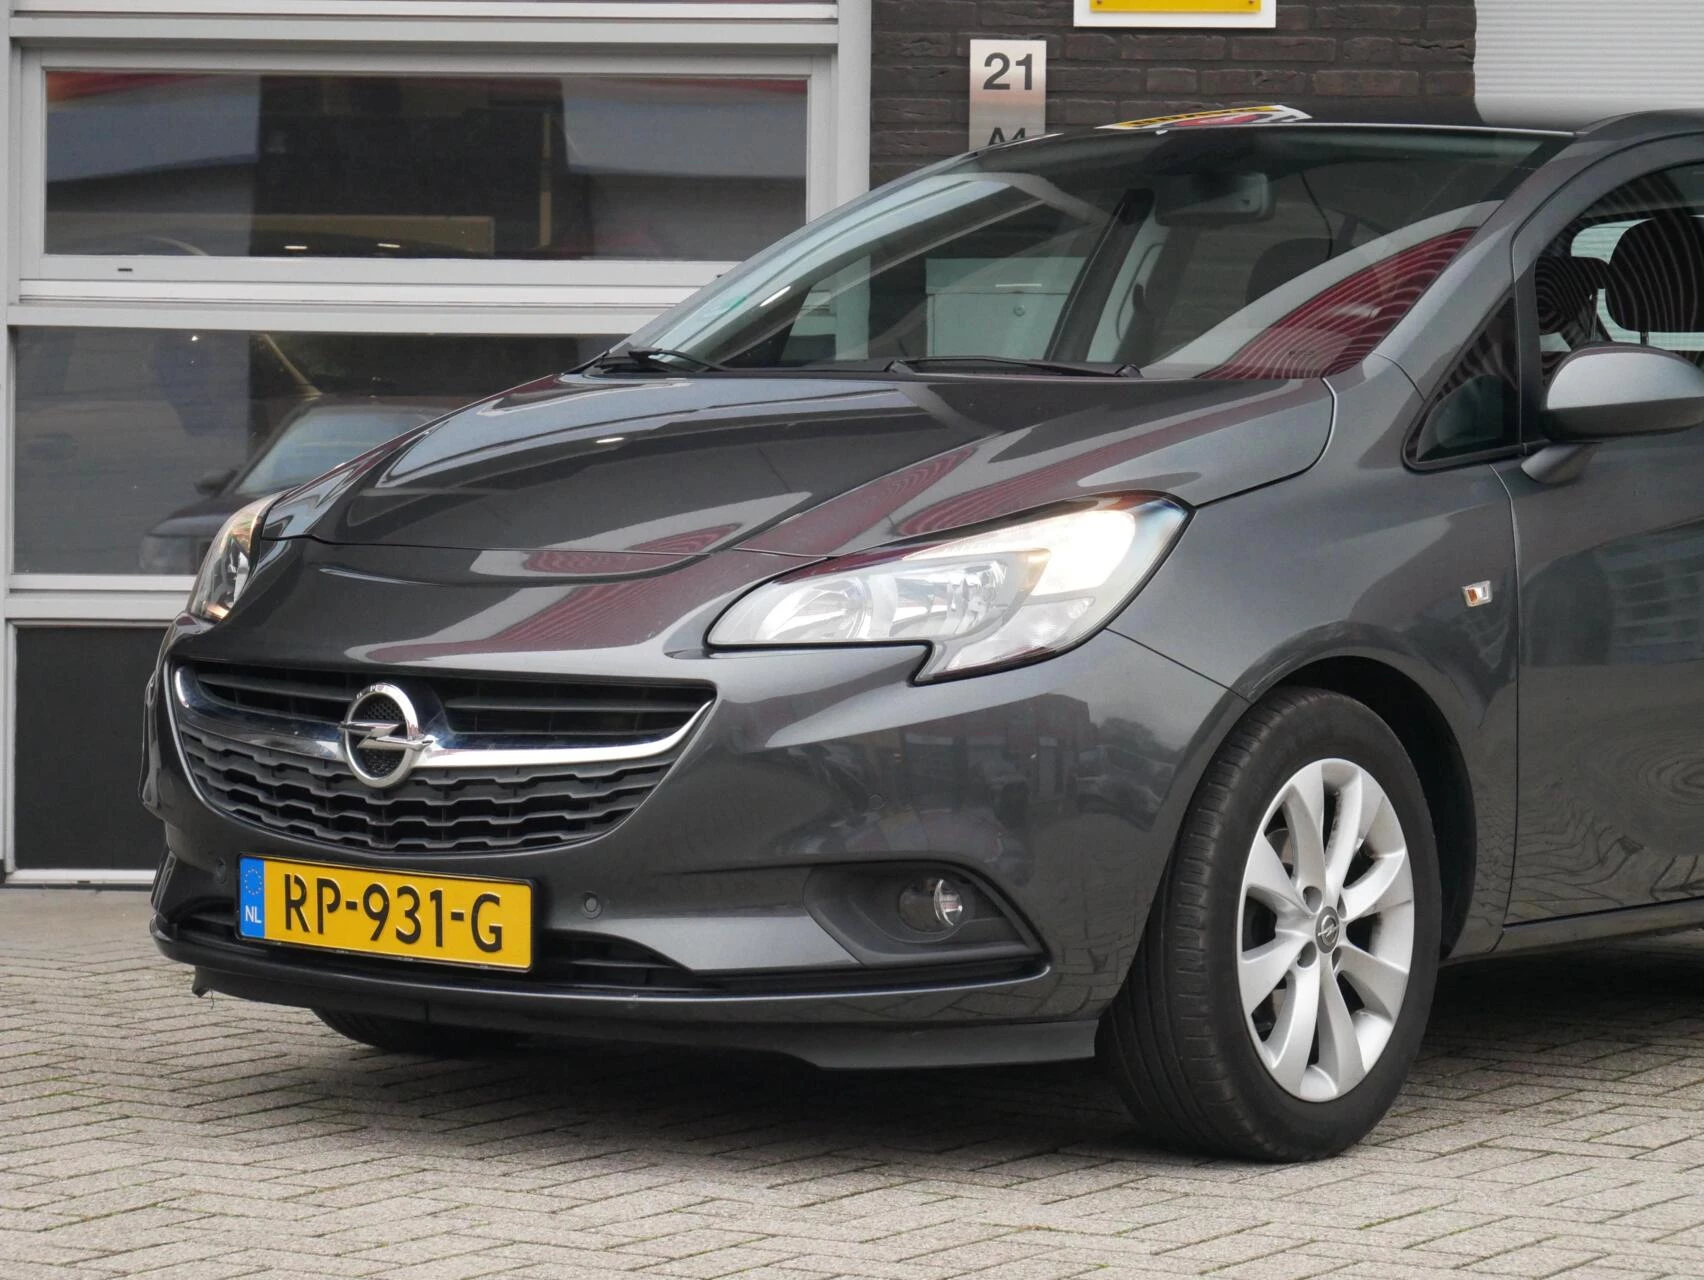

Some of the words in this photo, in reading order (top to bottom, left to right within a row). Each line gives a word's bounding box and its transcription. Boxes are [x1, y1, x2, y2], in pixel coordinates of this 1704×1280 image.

[983, 52, 1032, 90] 21
[245, 905, 262, 924] NL
[284, 873, 502, 953] RP-931-G
